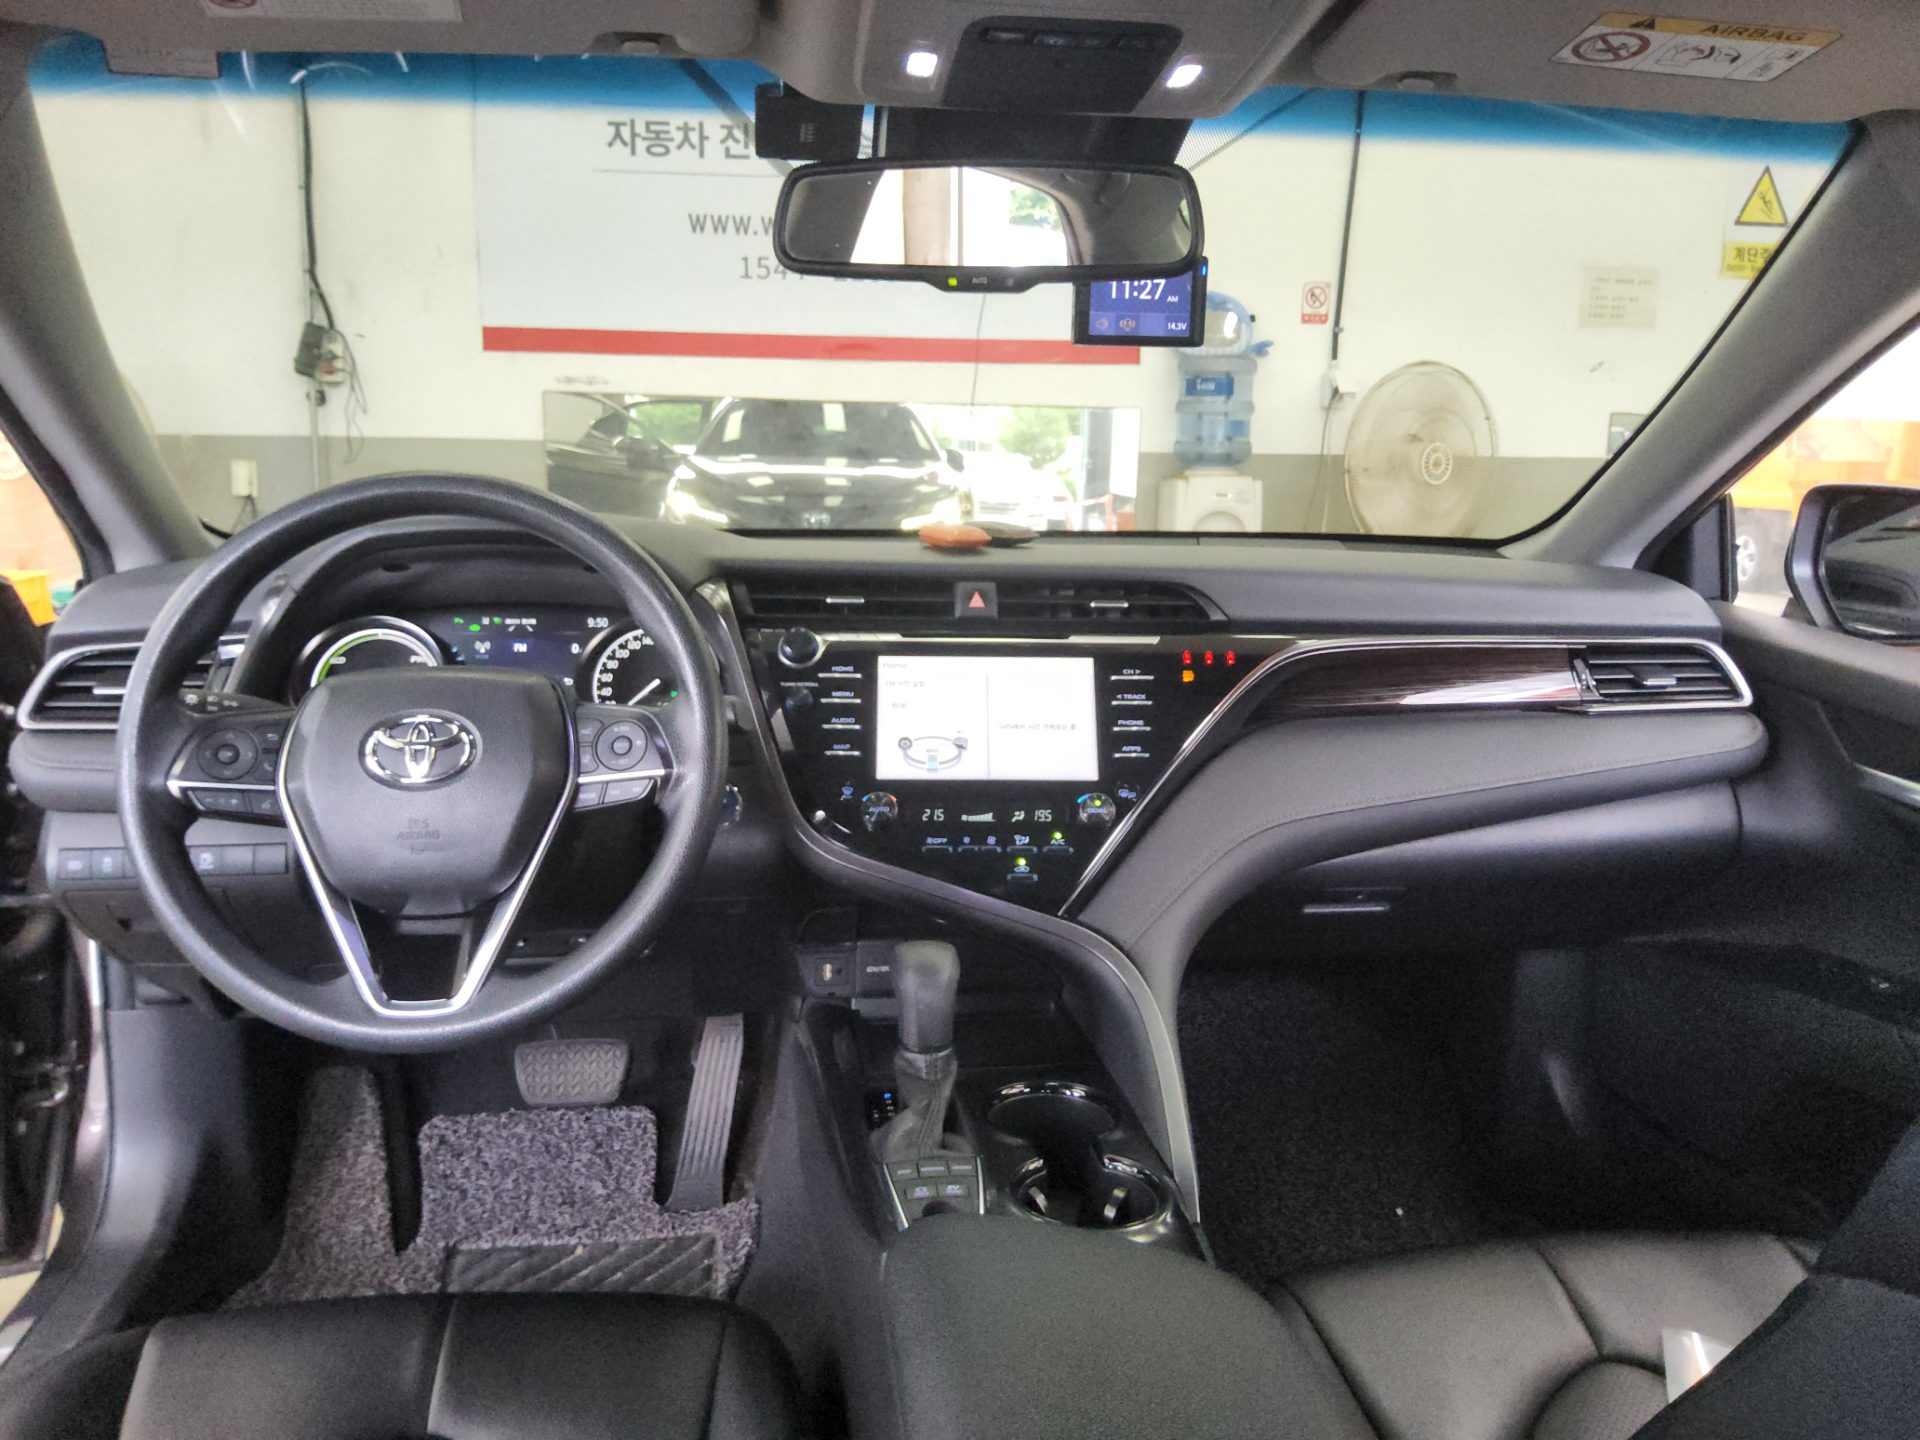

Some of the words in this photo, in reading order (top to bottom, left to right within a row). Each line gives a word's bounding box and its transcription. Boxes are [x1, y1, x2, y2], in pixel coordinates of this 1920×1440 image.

[1700, 24, 1808, 42] AIRBAG
[606, 117, 710, 159] 자동차
[719, 121, 752, 160] 진
[687, 212, 775, 236] www.w
[1108, 278, 1166, 300] 11:27
[1166, 295, 1179, 303] AM
[587, 617, 609, 628] 9:50
